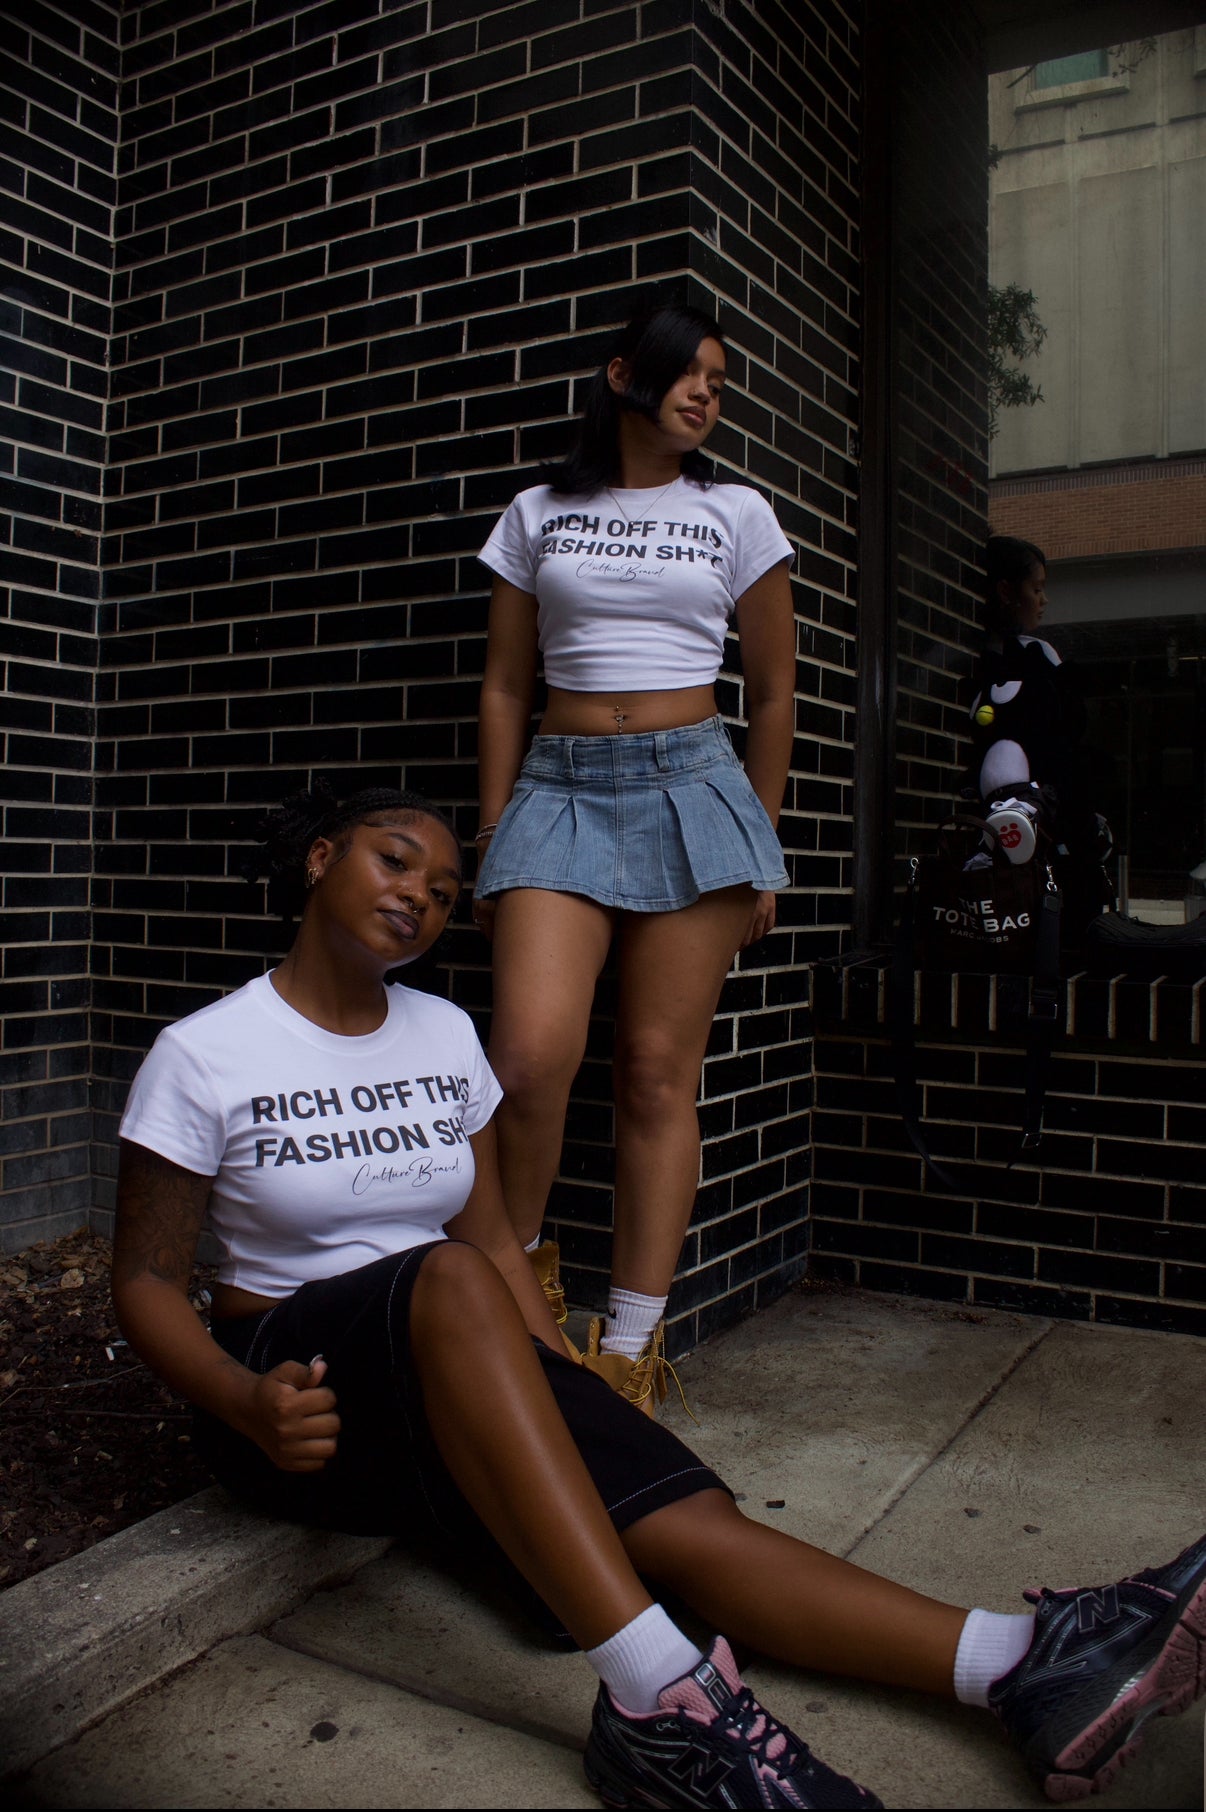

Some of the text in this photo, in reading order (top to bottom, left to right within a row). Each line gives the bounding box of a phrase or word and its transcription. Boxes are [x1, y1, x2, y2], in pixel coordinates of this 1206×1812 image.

[541, 513, 725, 549] RICH OFF THIS
[932, 906, 1031, 933] TOTE BAG
[958, 897, 994, 914] THE
[251, 1075, 470, 1125] RICH OFF THIS
[255, 1123, 430, 1167] FASHION
